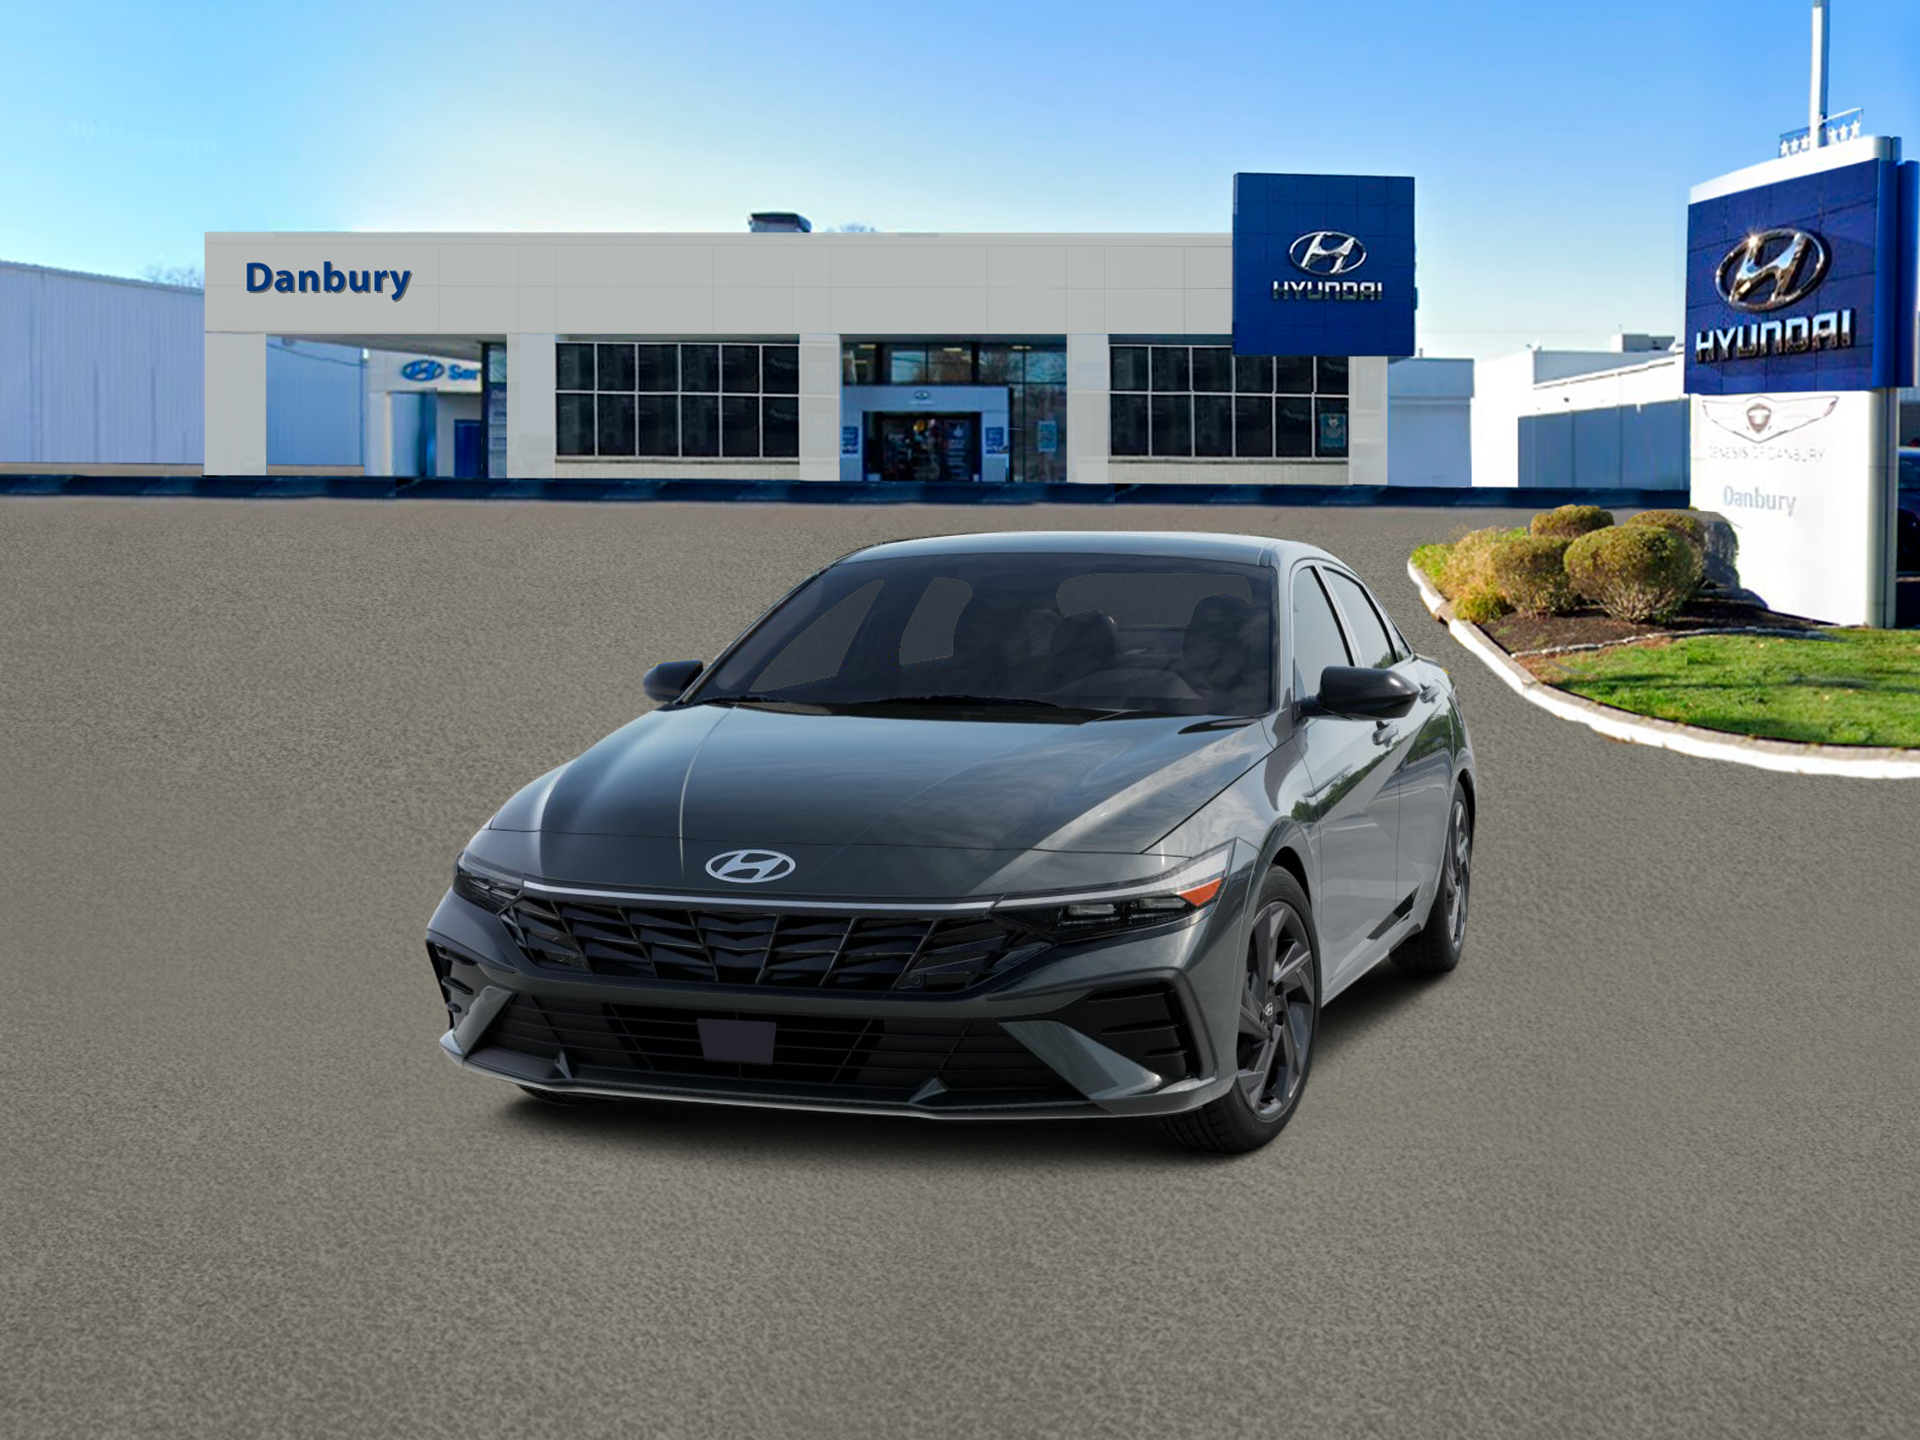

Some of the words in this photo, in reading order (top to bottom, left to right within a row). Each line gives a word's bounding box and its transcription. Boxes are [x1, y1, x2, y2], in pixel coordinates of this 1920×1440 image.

[246, 261, 412, 302] Danbury
[1272, 281, 1383, 300] HYUNDAI
[1695, 309, 1853, 363] HYUNDAI
[1723, 485, 1797, 517] Danbury
